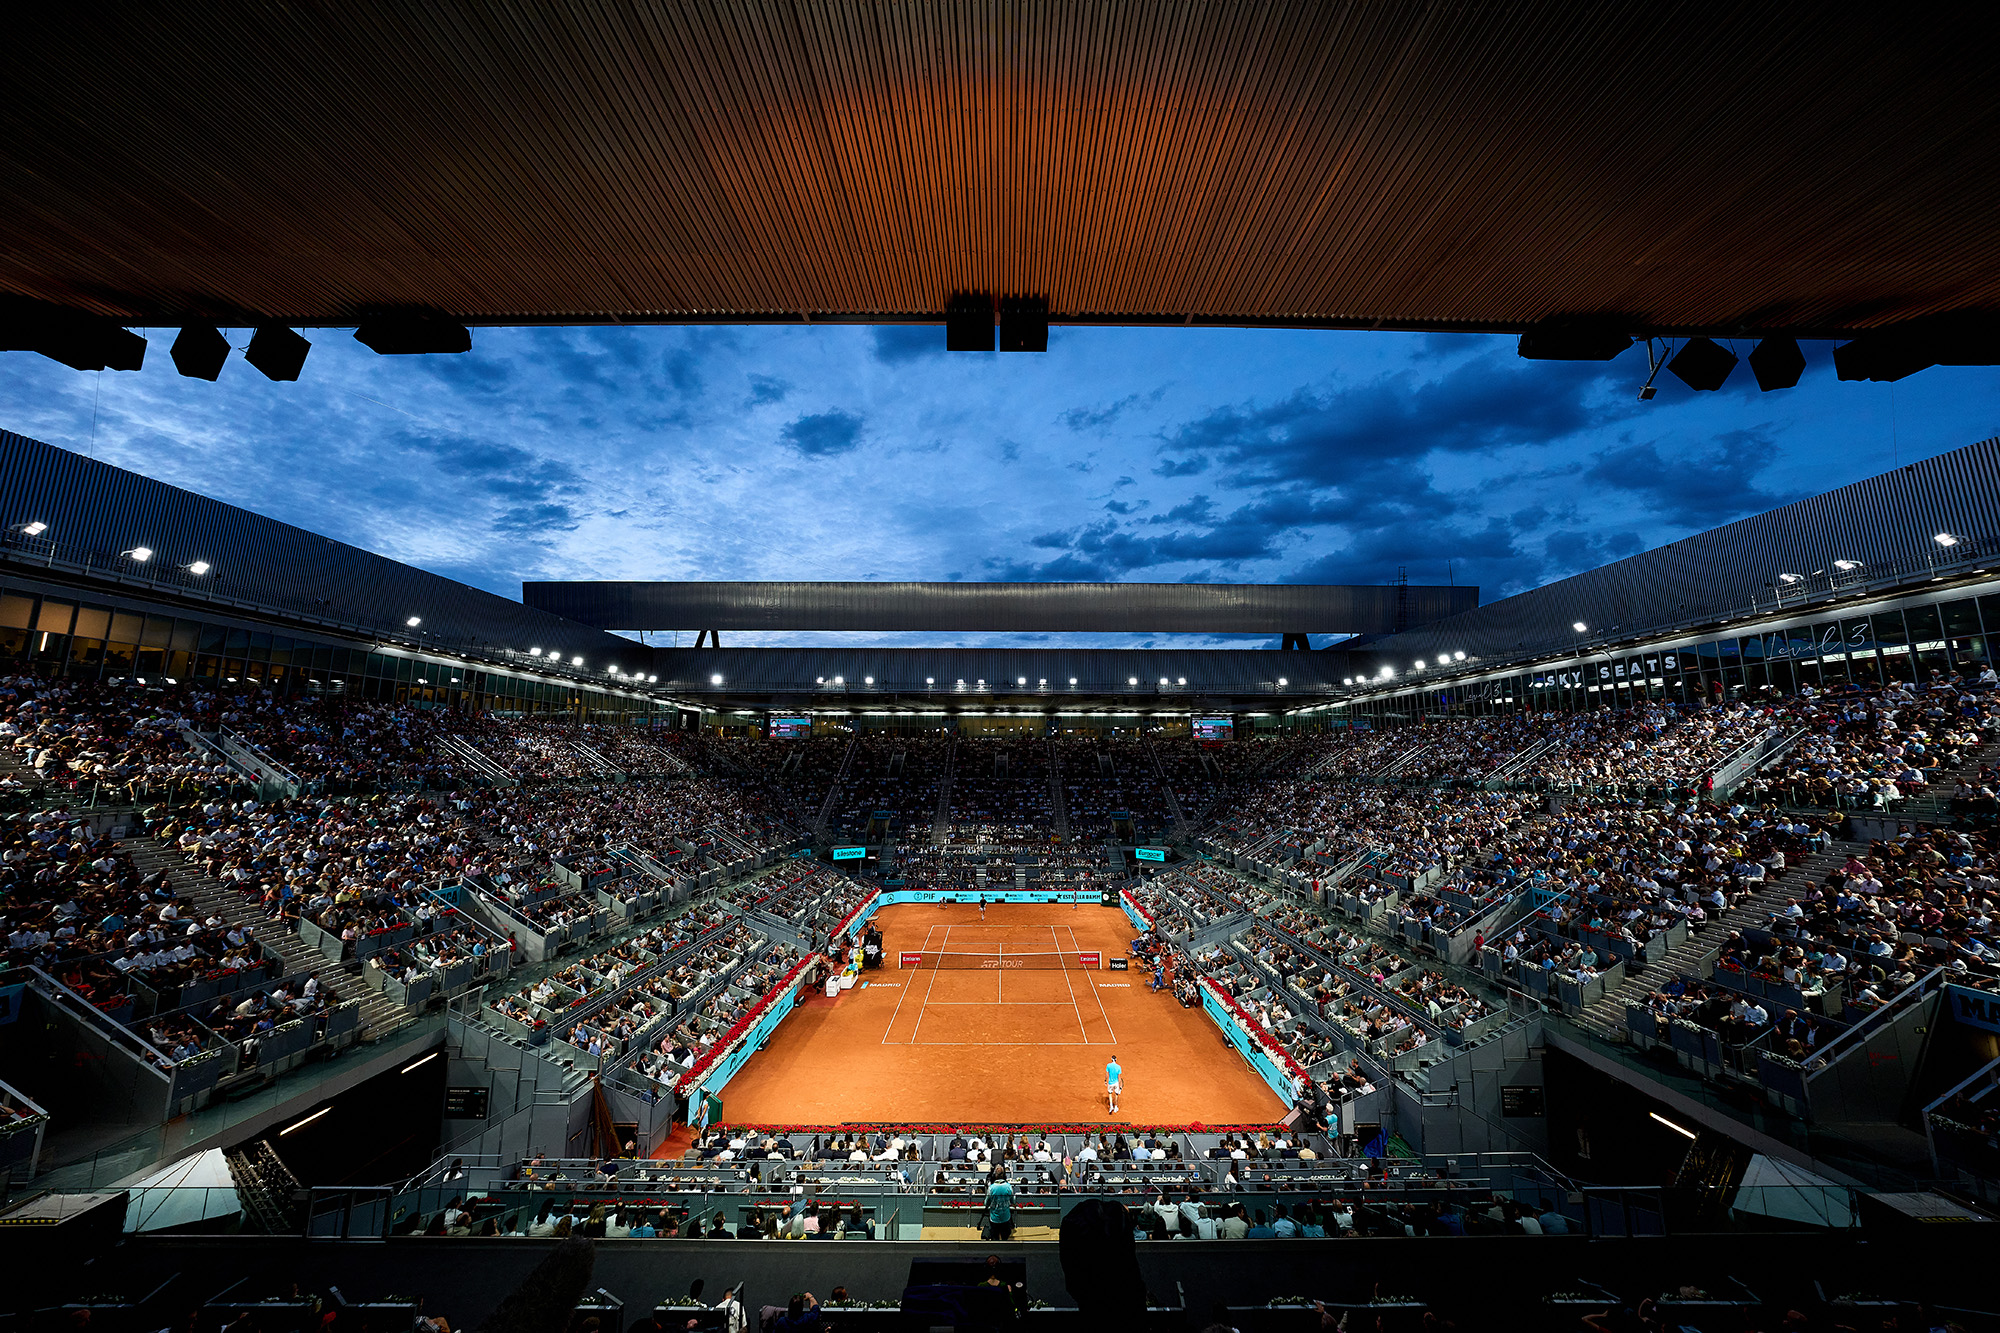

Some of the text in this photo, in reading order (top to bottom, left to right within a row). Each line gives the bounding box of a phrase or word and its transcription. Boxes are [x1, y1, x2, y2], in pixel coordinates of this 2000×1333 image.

[1766, 624, 1869, 660] Level 3
[1547, 656, 1676, 686] SKY SEATS
[1002, 960, 1024, 968] TOUR
